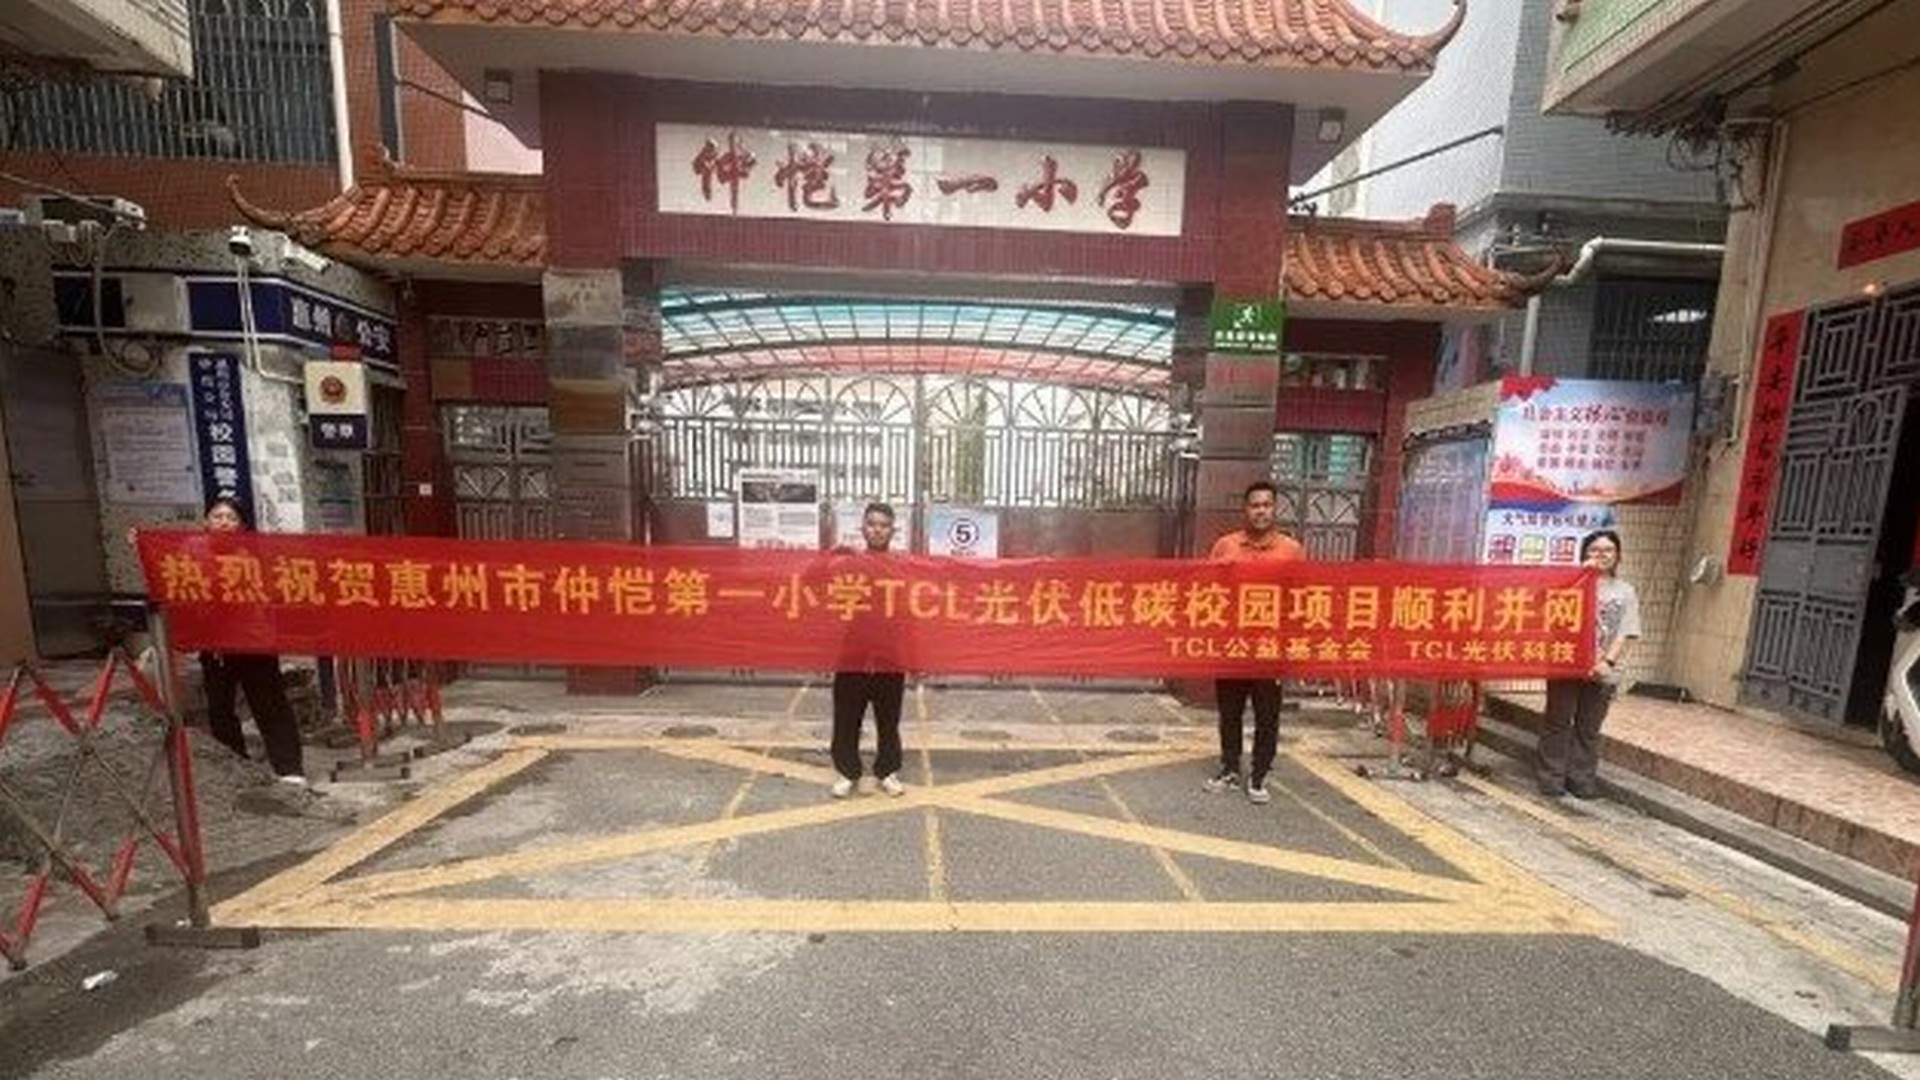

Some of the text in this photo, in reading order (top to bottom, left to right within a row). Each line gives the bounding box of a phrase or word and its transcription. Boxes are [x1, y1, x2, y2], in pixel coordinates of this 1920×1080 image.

[693, 132, 1151, 230] 仲恺第一小学
[956, 524, 971, 544] 5
[160, 554, 1584, 632] 热烈祝贺惠州市仲恺第一小学TCL光伏低碳校园项目顺利并网
[1166, 637, 1577, 664] TCL公益基金会 TCL光伏科技
